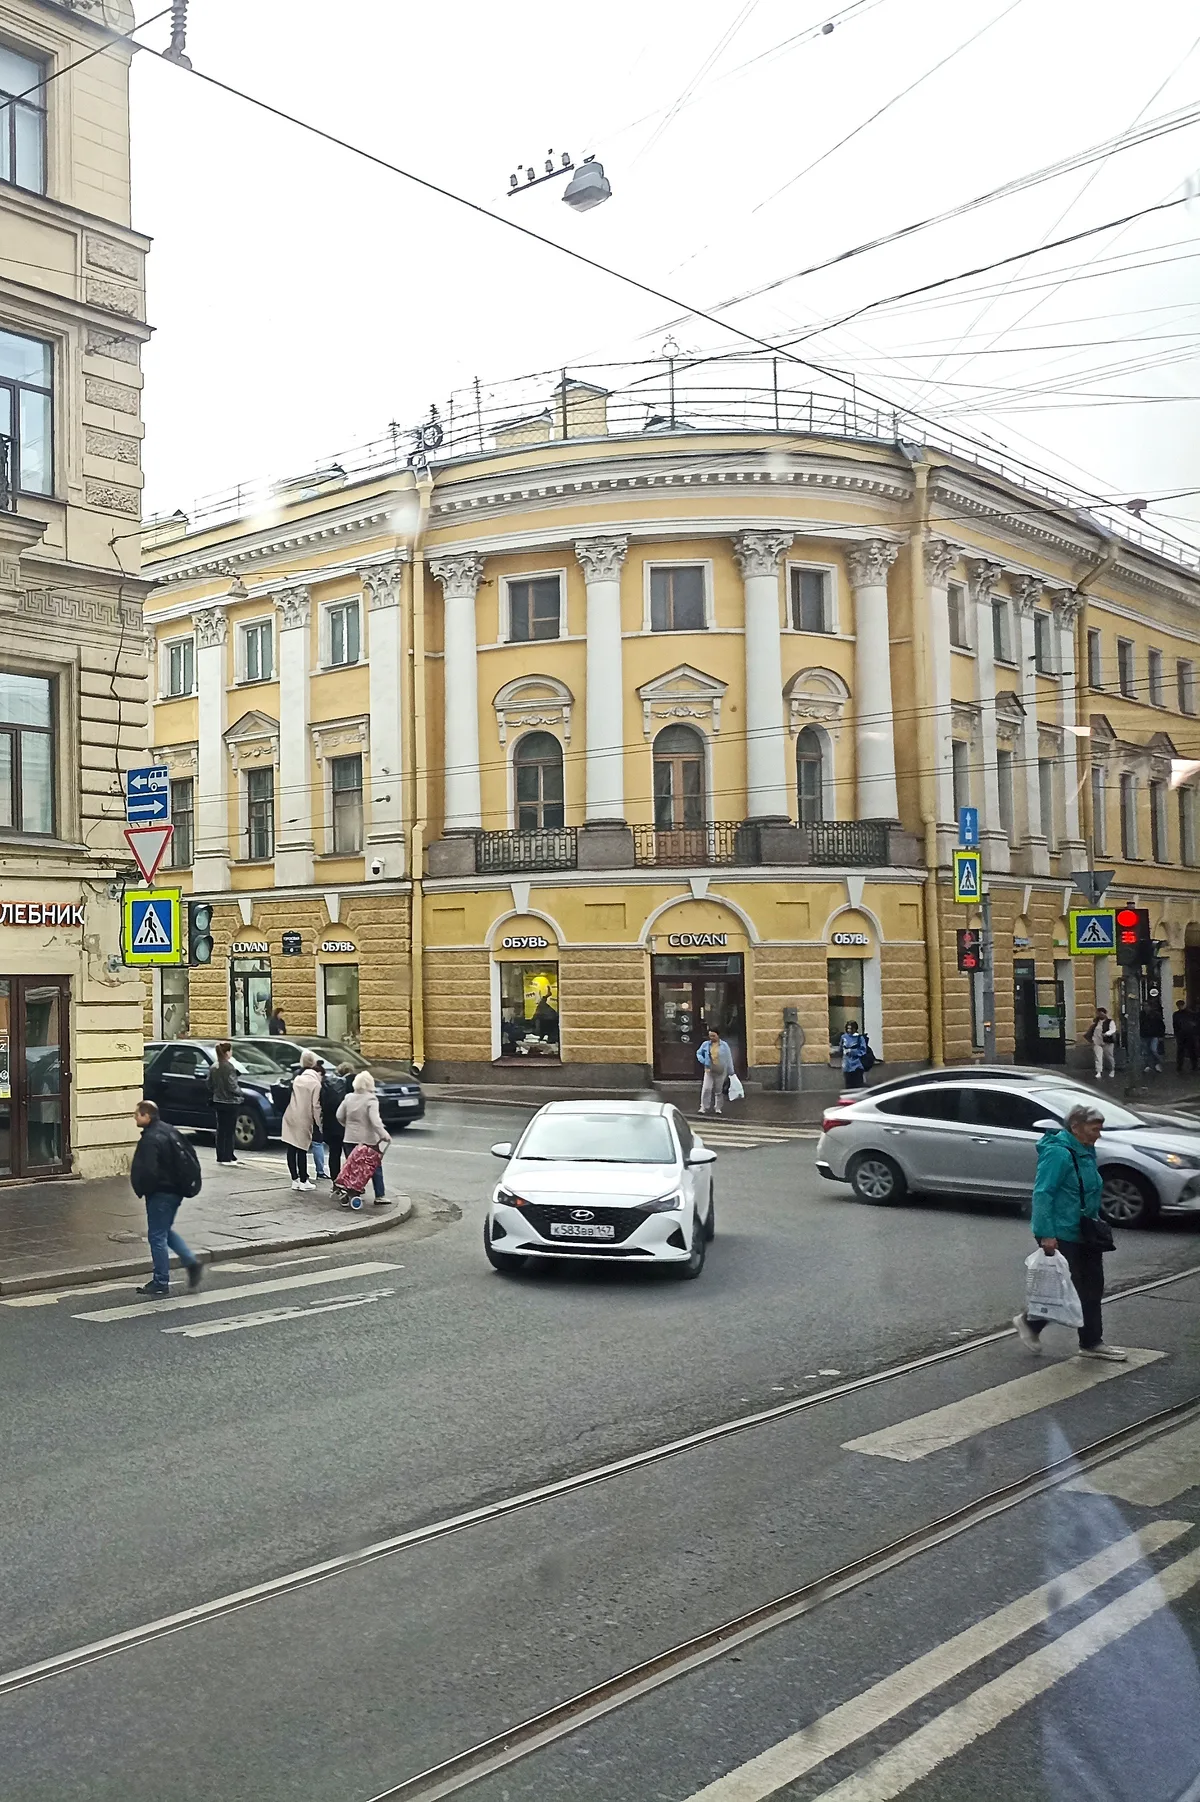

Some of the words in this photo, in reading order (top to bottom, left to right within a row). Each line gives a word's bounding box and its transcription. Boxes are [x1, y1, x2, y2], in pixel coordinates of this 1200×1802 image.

[502, 937, 548, 948] ОБУВЬ
[669, 932, 729, 947] COVANI
[833, 933, 870, 945] ОБУВЬ
[232, 942, 268, 953] COVANI
[321, 941, 355, 953] ОБУВЬ
